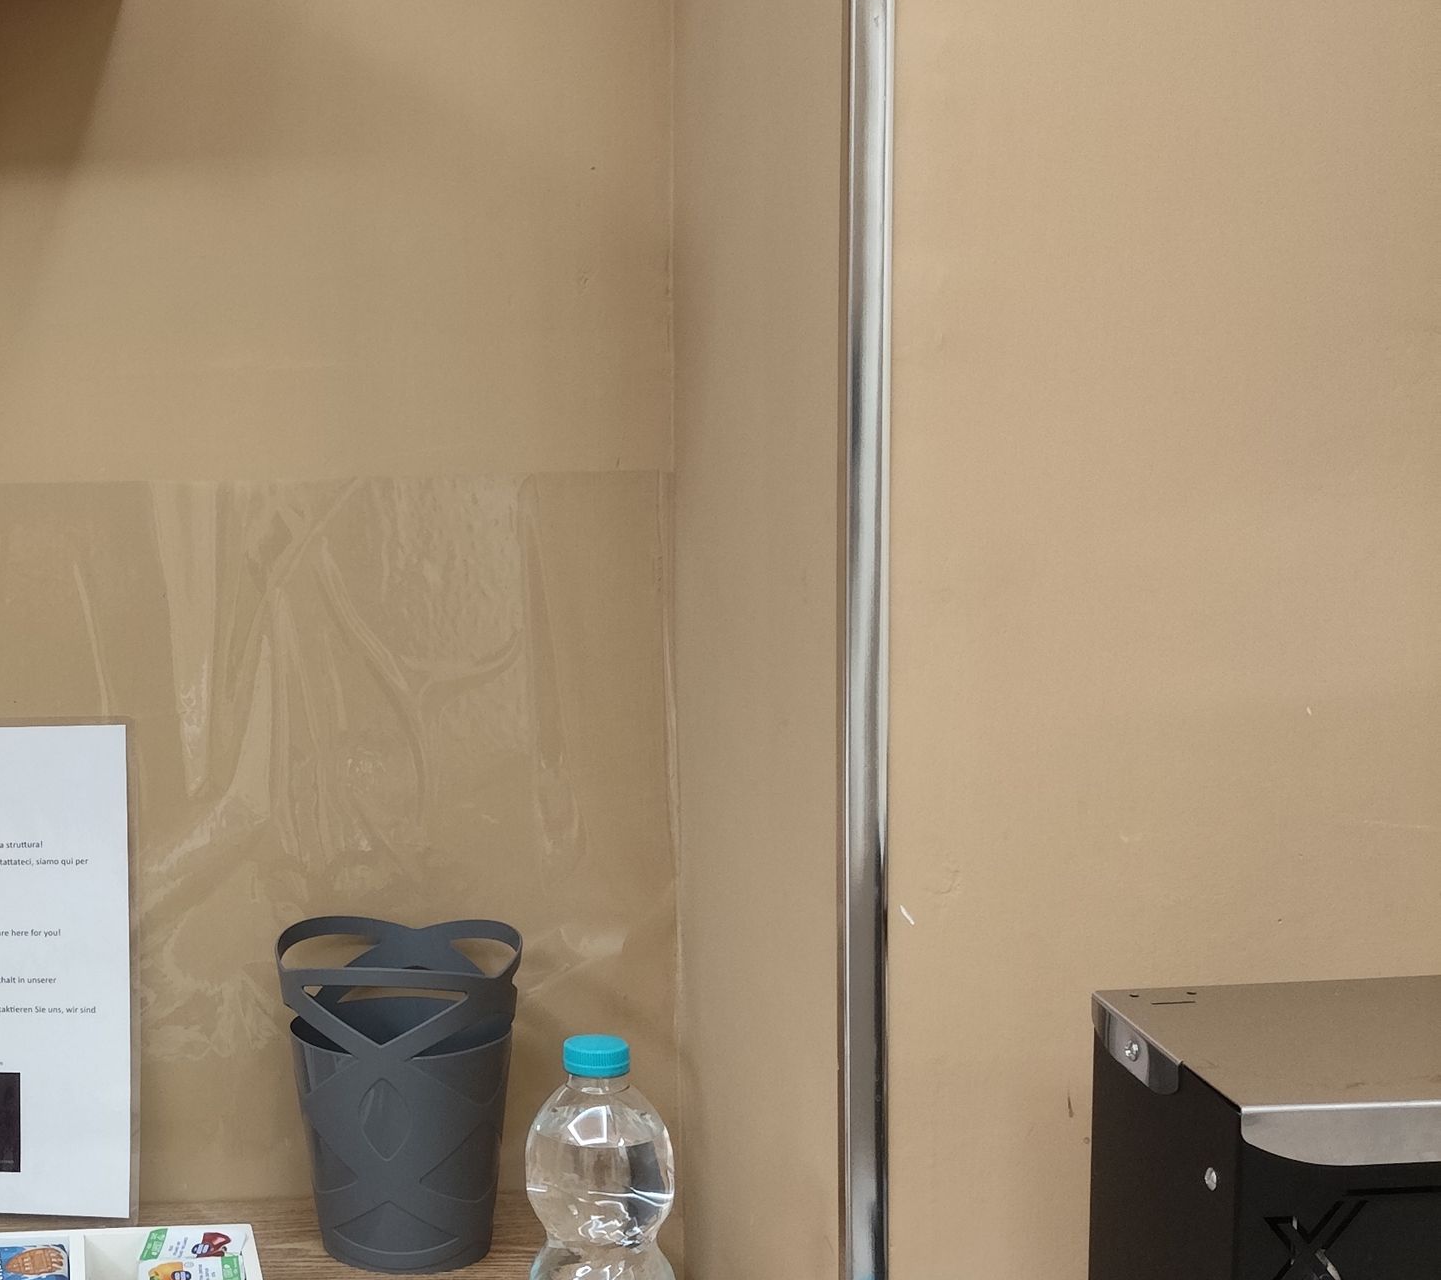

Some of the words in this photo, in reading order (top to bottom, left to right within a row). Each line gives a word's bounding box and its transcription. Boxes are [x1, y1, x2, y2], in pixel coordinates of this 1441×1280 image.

[6, 841, 43, 849] struttura!
[36, 858, 59, 866] siamo
[60, 858, 74, 867] qui
[75, 858, 89, 867] per
[11, 929, 29, 937] here
[31, 929, 42, 937] for
[43, 929, 61, 938] you!
[18, 976, 26, 984] in
[34, 1006, 46, 1014] Sie
[65, 1006, 79, 1014] wir
[80, 1006, 97, 1014] sind
